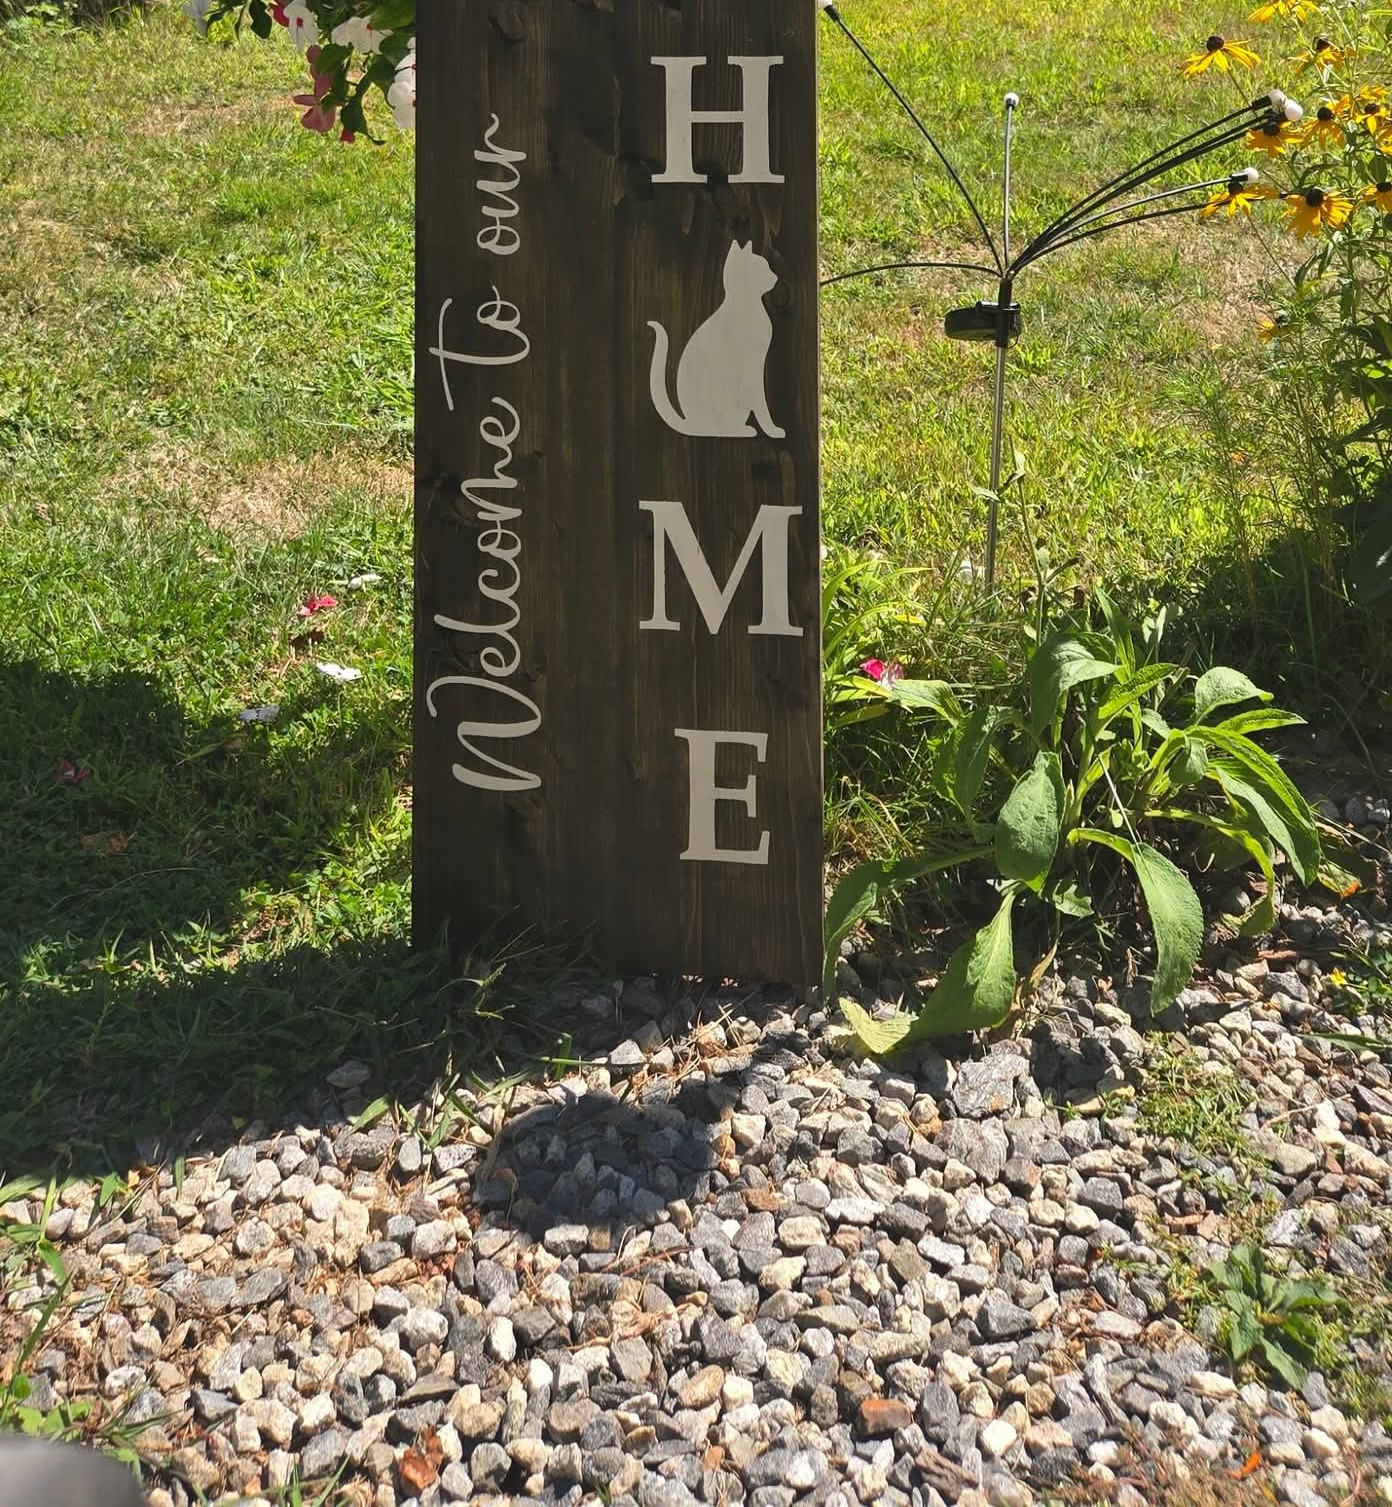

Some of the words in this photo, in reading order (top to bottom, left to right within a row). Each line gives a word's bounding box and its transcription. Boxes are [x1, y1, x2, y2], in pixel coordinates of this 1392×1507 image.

[475, 113, 528, 256] our
[429, 286, 531, 411] to
[639, 55, 804, 865] HME
[427, 397, 541, 793] Welcome
